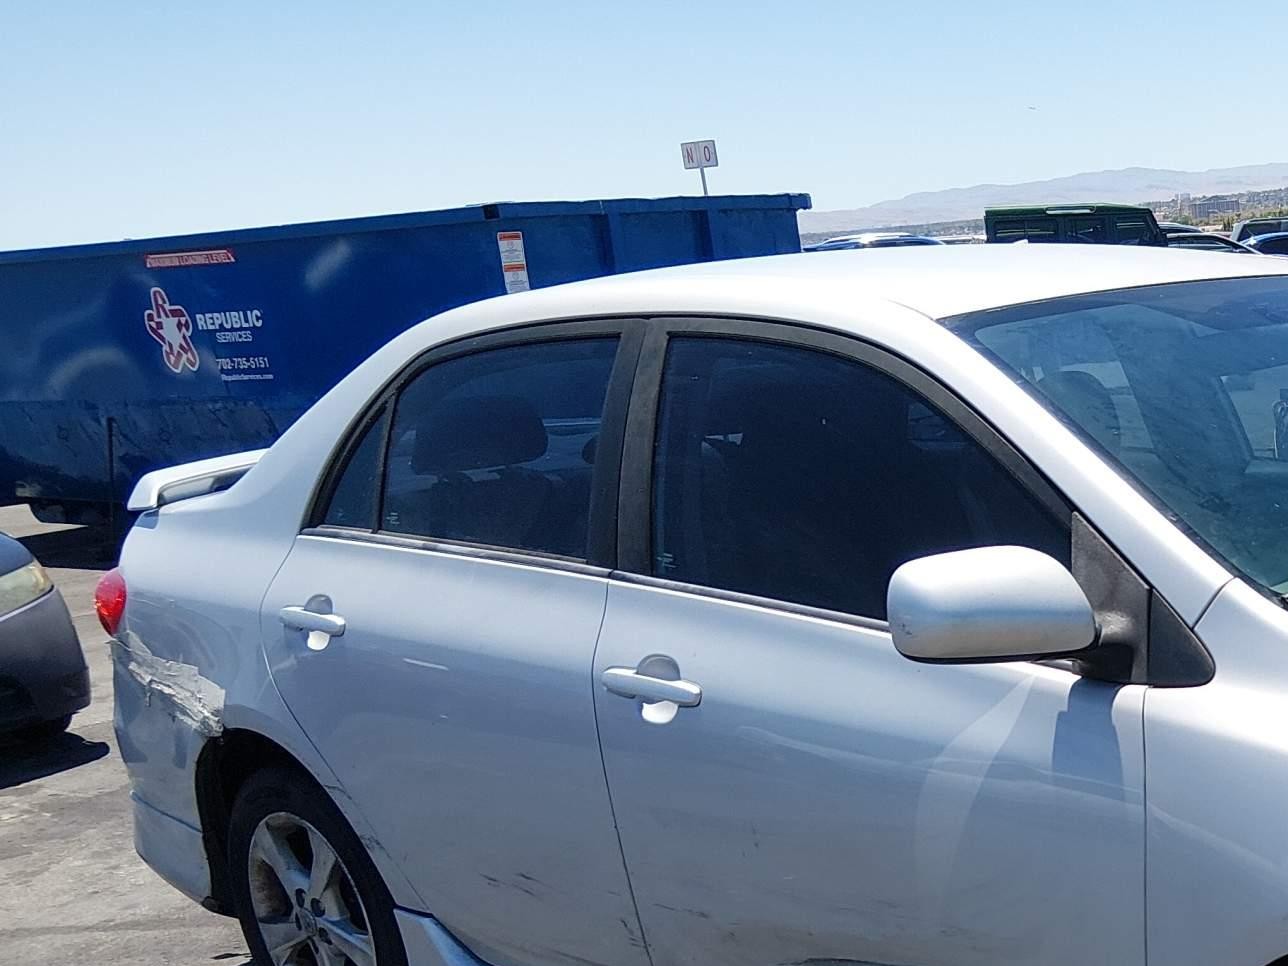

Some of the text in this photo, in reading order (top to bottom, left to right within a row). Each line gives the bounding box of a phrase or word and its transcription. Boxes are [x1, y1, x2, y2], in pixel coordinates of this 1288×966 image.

[195, 309, 263, 330] REPUBLIC
[216, 331, 253, 343] SERVICES
[216, 357, 270, 370] 702-735-5151
